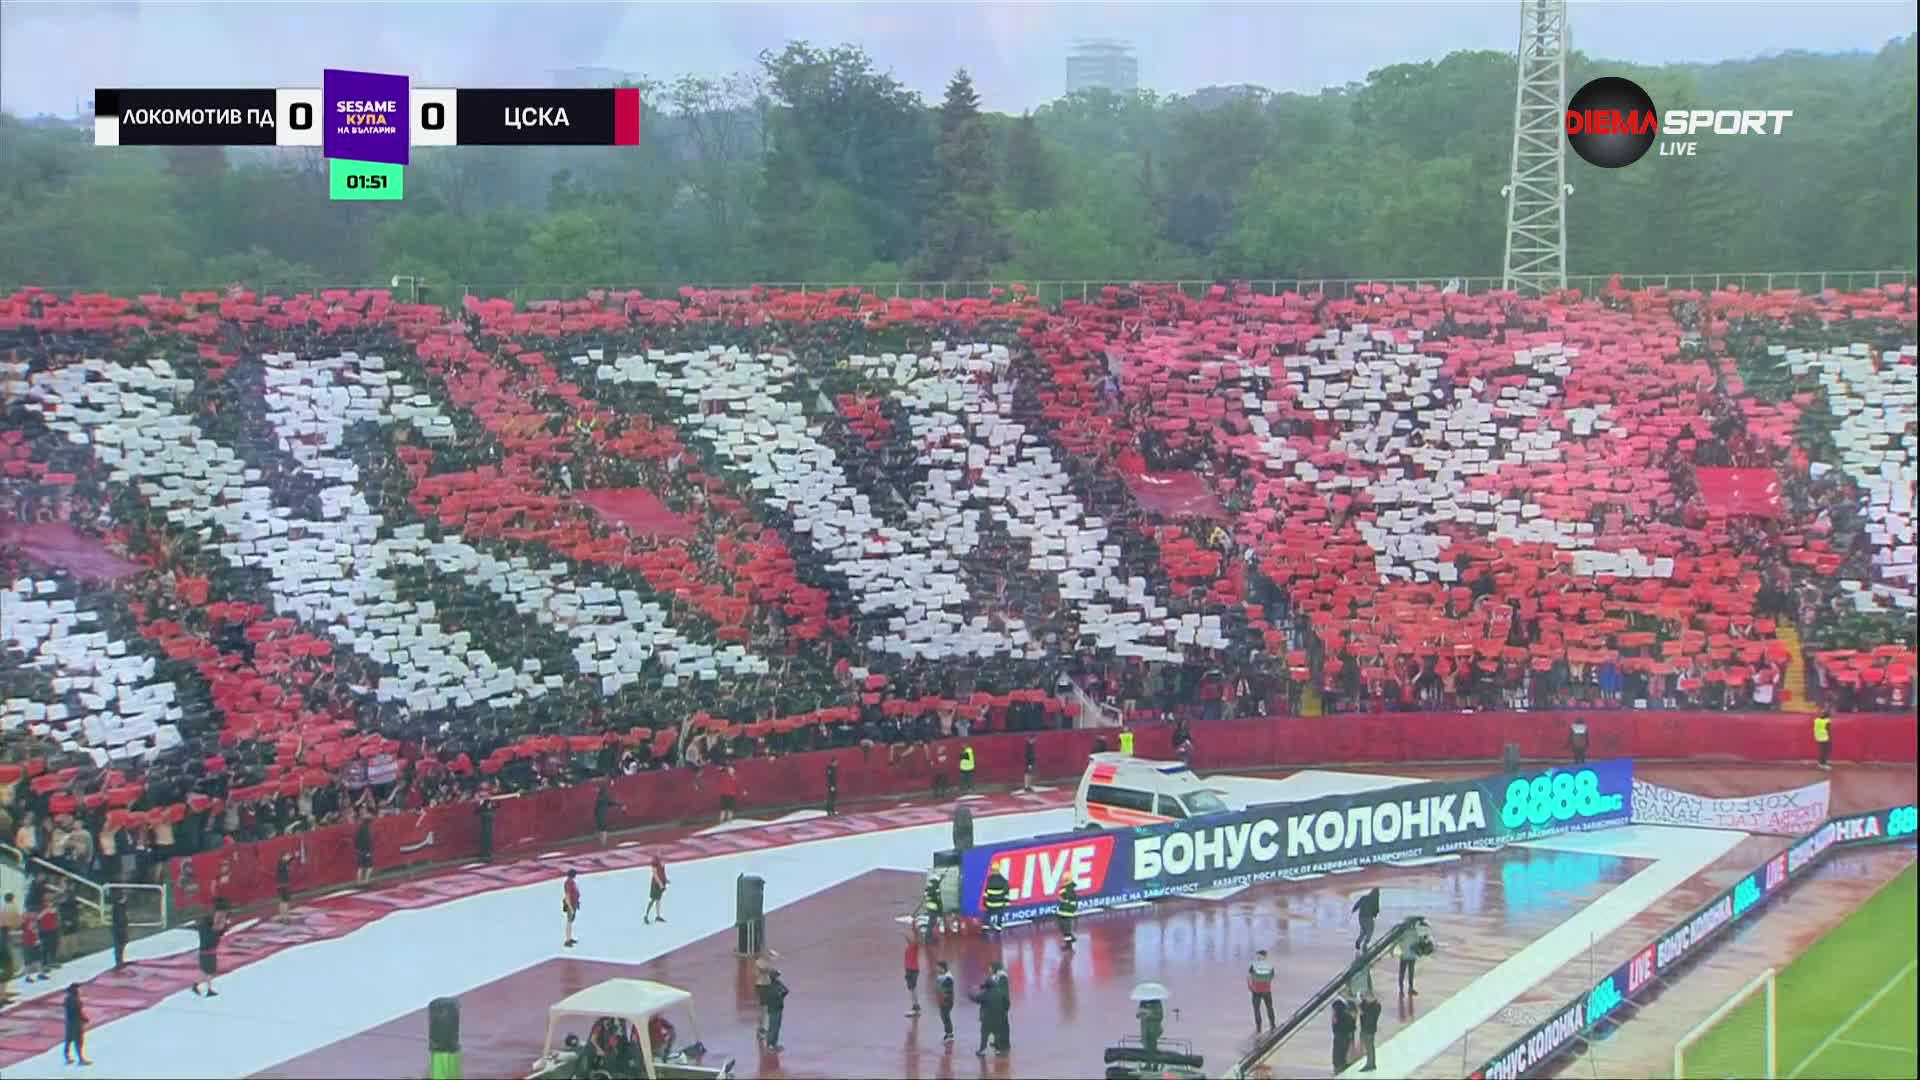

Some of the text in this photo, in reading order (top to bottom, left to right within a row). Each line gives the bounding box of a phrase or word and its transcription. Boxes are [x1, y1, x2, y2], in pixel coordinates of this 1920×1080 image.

[1134, 818, 1279, 881] БОНУС
[1287, 790, 1487, 856] КОЛОНКА
[997, 845, 1096, 900] LIVE
[1038, 905, 1060, 916] РИС
[1629, 950, 1651, 992] LIVE
[1528, 1003, 1583, 1066] КОЛОНКА
